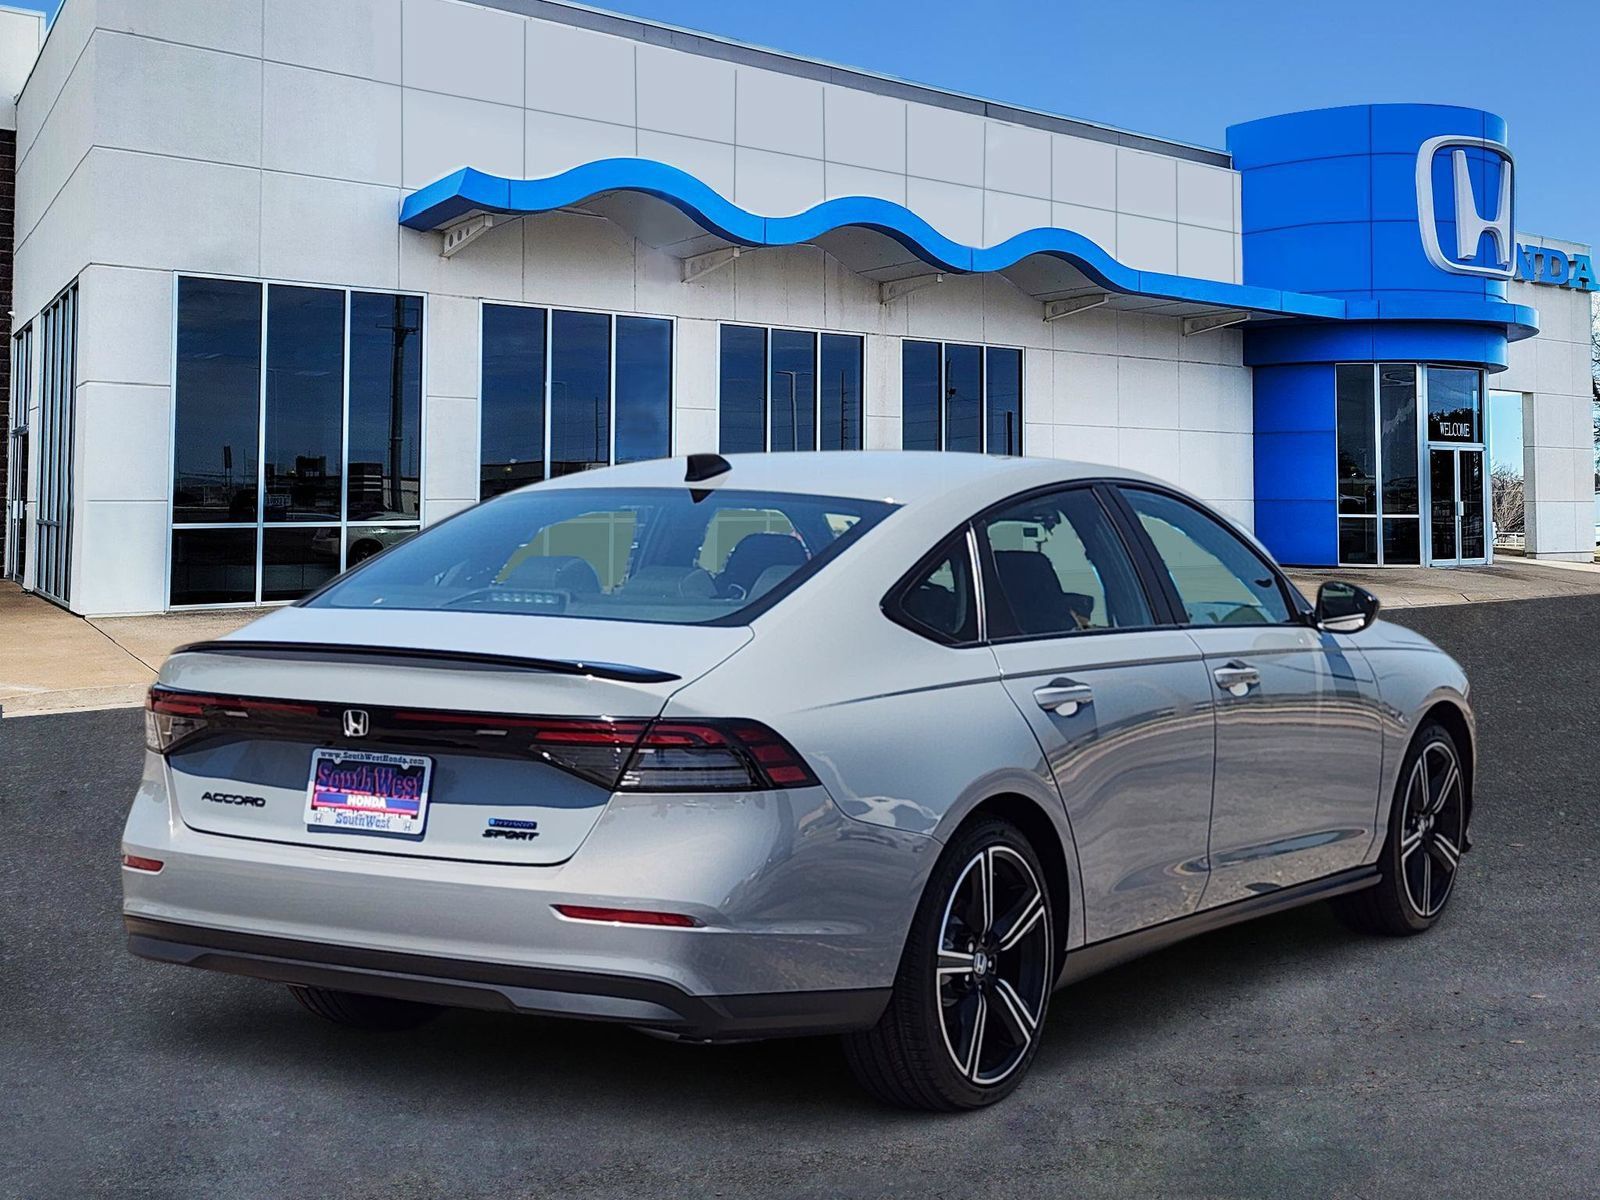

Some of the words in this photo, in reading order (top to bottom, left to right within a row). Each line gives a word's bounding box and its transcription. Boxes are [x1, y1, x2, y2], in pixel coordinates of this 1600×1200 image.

[1515, 243, 1600, 291] NDA
[1440, 422, 1470, 437] WELCOME
[201, 791, 266, 808] ACCORD
[346, 794, 387, 808] HONDA
[335, 812, 391, 829] SouthWest
[482, 829, 540, 841] SPORT
